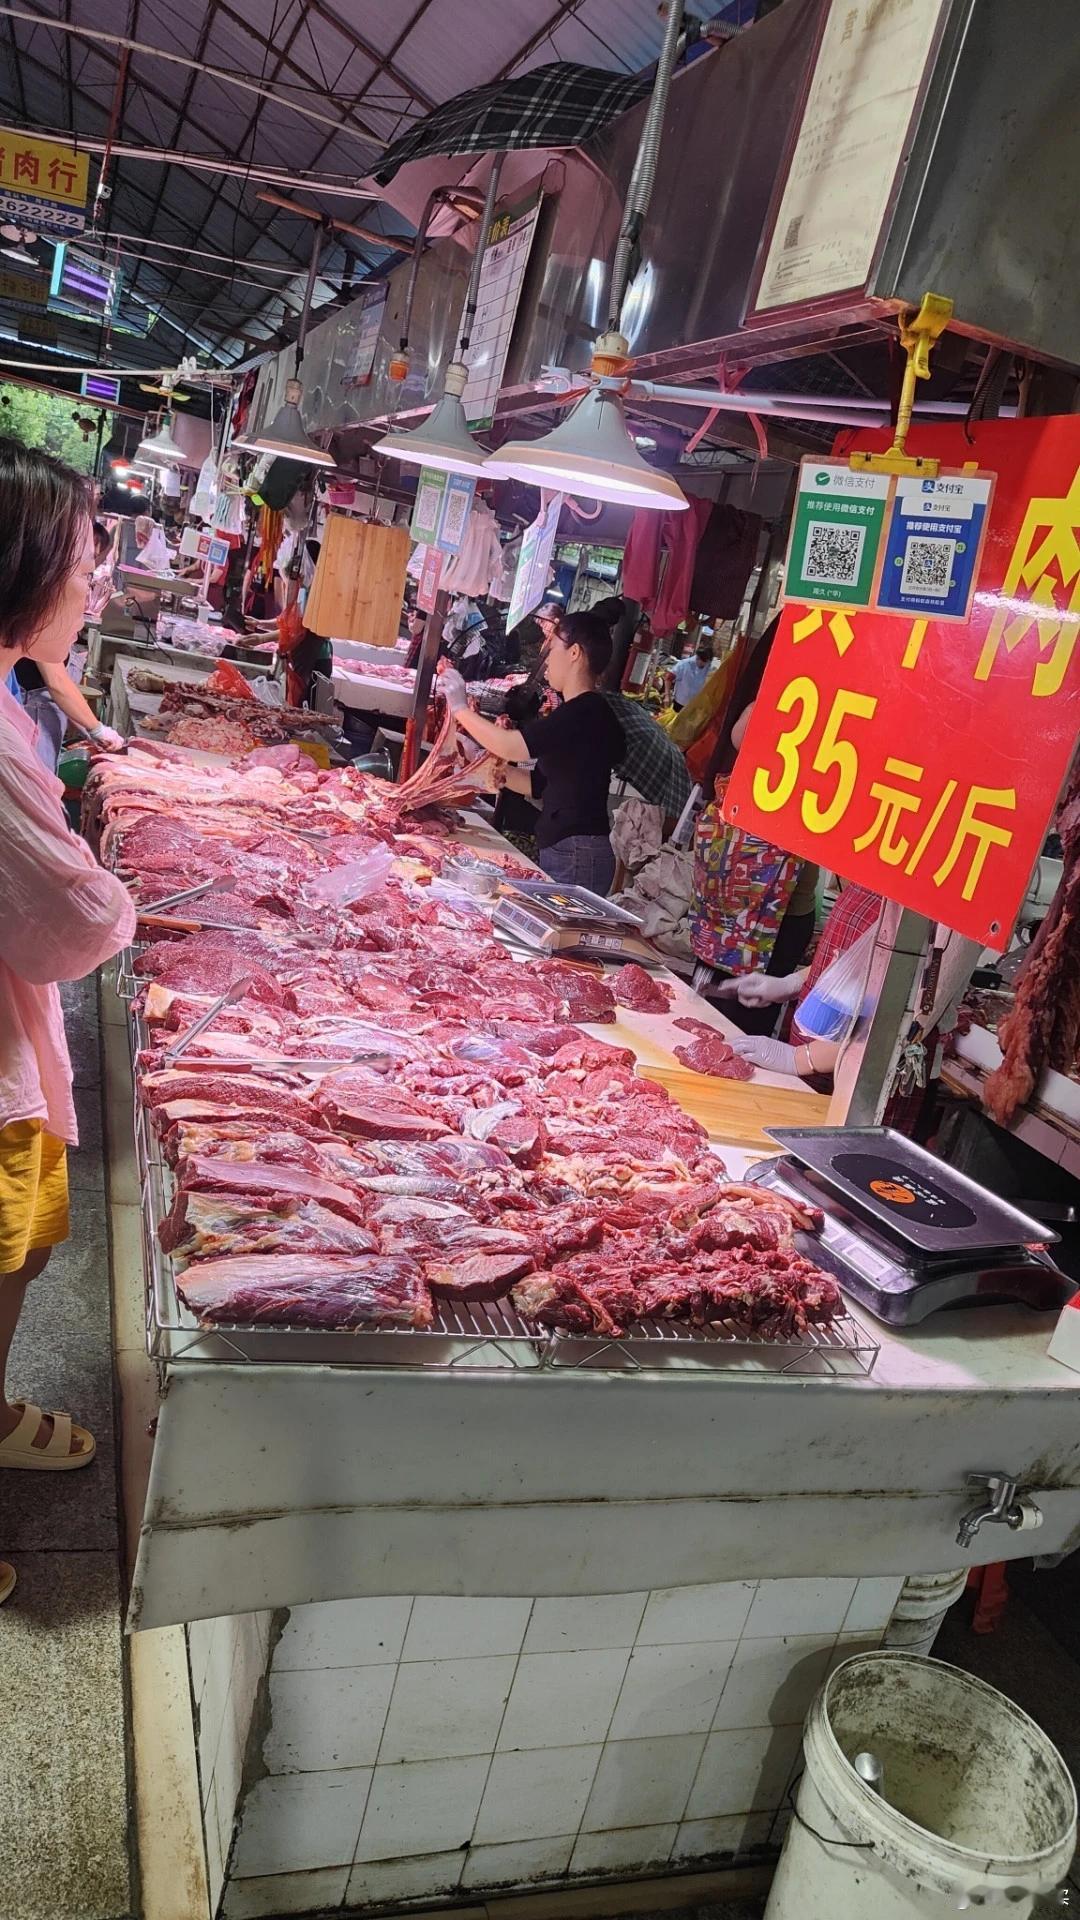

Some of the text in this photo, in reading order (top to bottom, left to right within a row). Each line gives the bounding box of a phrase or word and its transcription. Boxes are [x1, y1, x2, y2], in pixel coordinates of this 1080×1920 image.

[833, 474, 876, 489] 微信支付
[936, 483, 964, 495] 支付宝
[806, 500, 875, 516] 推荐使用微信支付
[933, 503, 951, 512] 支付宝
[906, 521, 962, 534] 推荐使用支付宝
[752, 676, 1017, 902] 35元/斤
